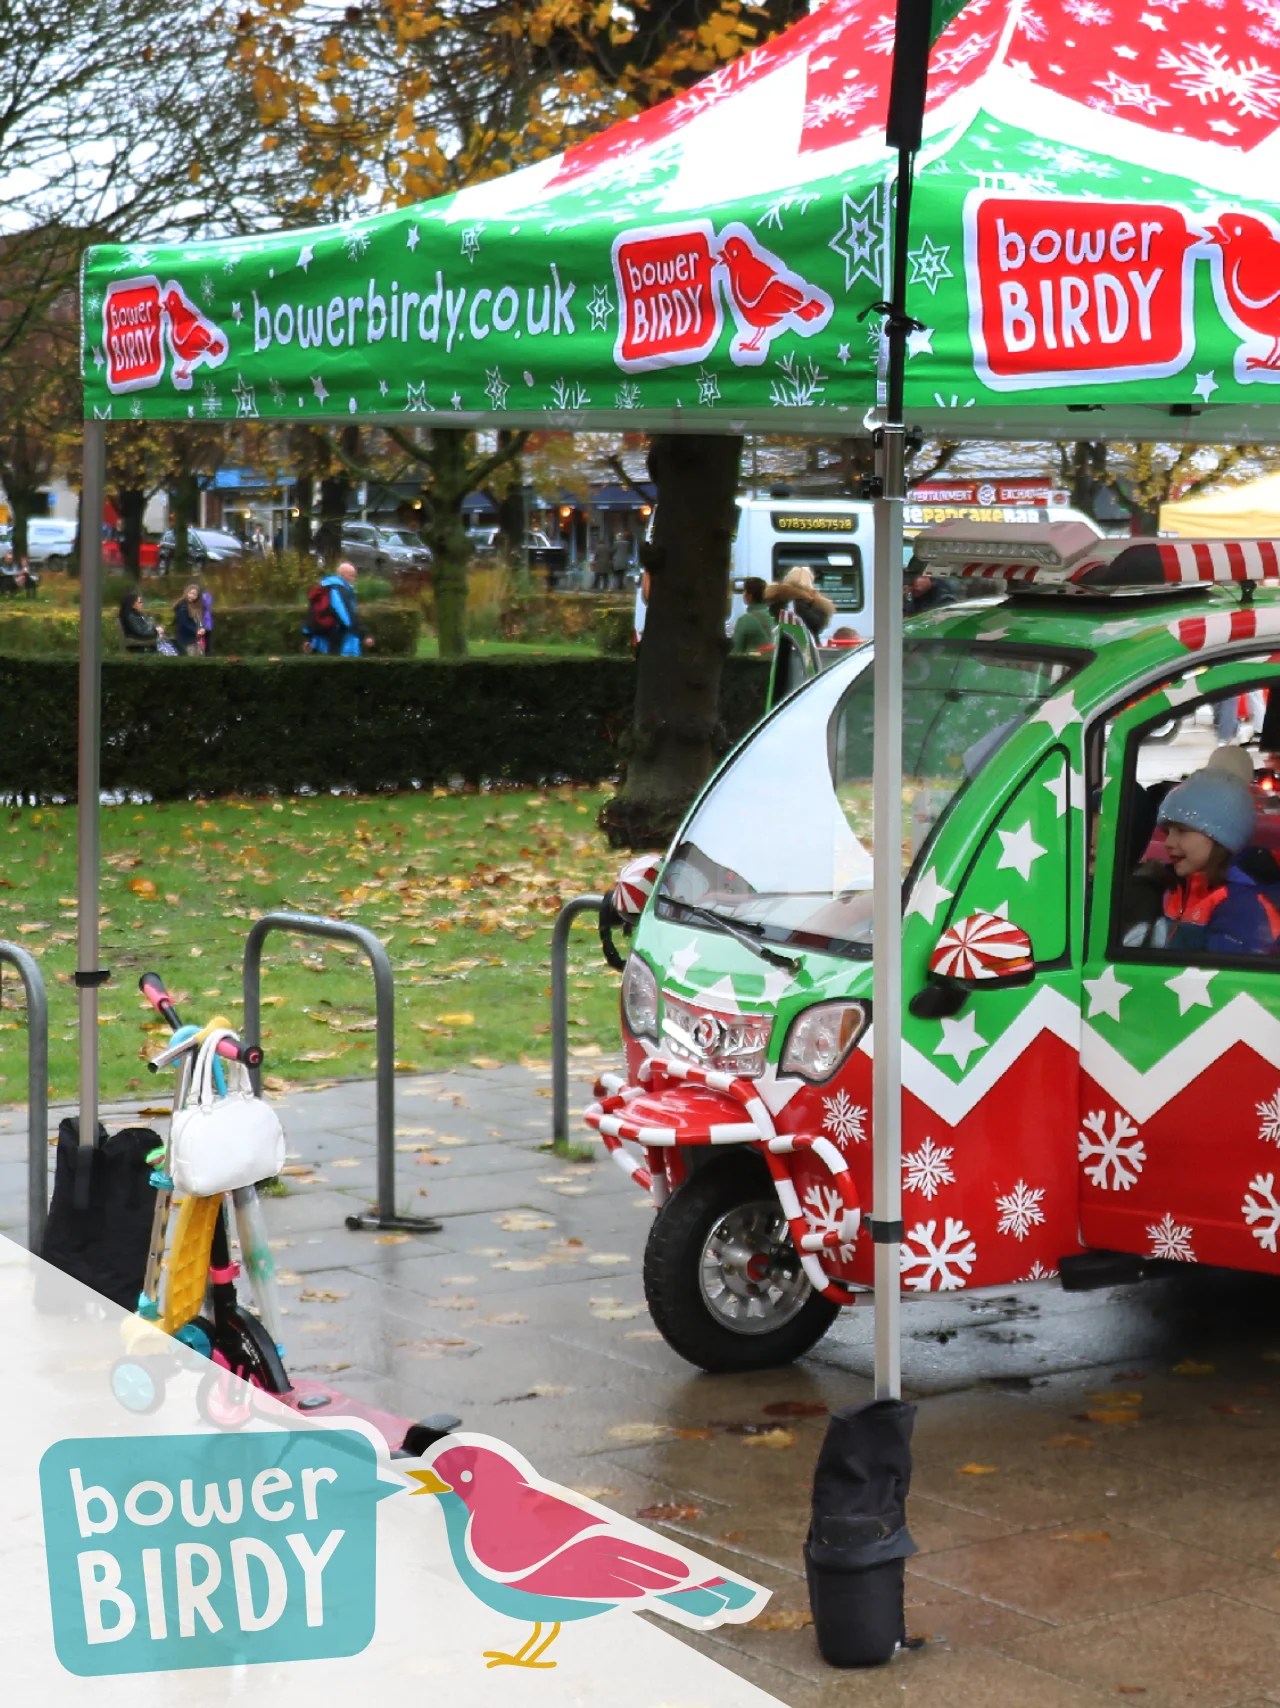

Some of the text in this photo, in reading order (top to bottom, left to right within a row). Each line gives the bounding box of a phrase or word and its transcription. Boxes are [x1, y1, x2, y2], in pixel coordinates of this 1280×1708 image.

[996, 218, 1165, 271] bower
[626, 249, 700, 294] bower
[111, 300, 153, 331] bower
[252, 262, 577, 354] bowerbirdy.co.uk
[631, 292, 709, 345] BIRDY
[999, 268, 1165, 353] BIRDY
[111, 326, 157, 372] BIRDY
